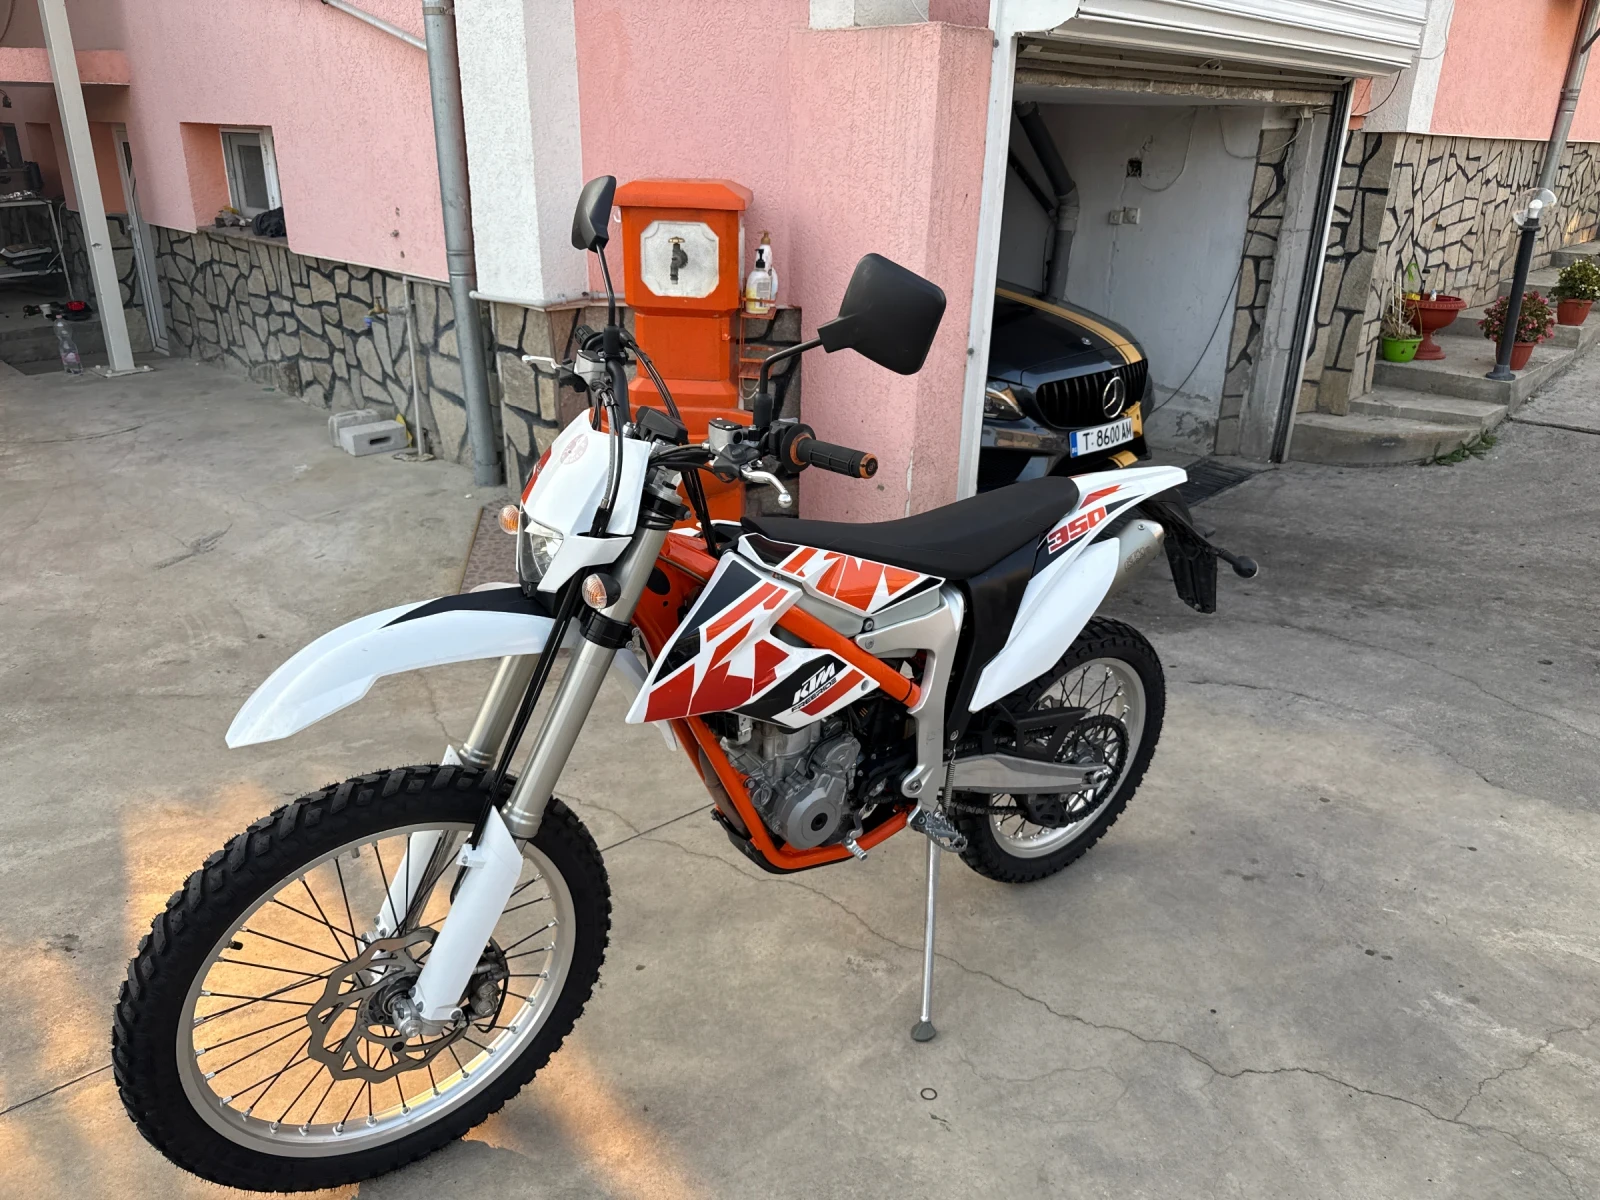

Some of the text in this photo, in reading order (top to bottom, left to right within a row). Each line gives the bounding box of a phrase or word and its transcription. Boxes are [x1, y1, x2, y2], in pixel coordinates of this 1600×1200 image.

[1082, 420, 1132, 451] T 8600 AM
[1047, 505, 1108, 555] 350
[791, 676, 837, 713] FREERIDE
[792, 662, 836, 706] KTM
